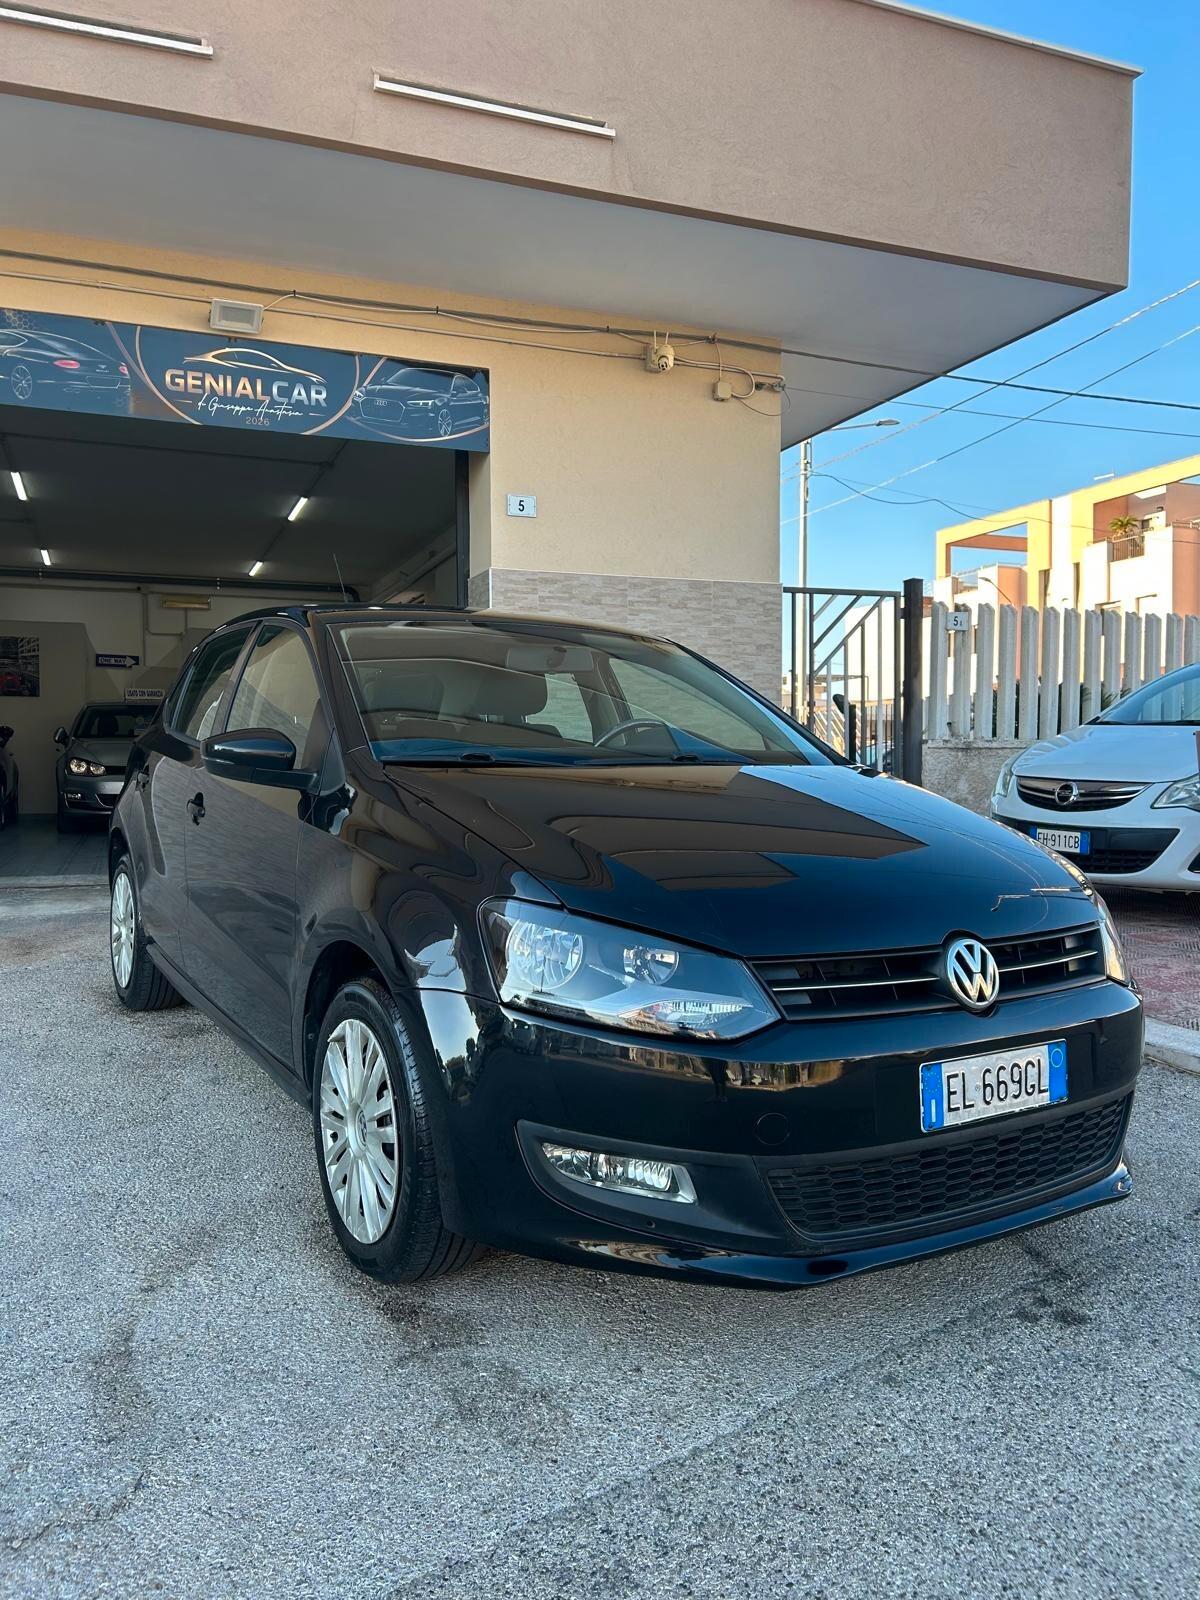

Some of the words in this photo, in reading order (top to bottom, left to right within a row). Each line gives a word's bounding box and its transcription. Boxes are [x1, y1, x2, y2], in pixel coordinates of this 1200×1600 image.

[165, 368, 328, 407] GENIALCAR
[208, 396, 253, 416] Giuseppe
[254, 399, 303, 420] Anastasia
[246, 416, 270, 426] 2026
[518, 499, 525, 512] 5
